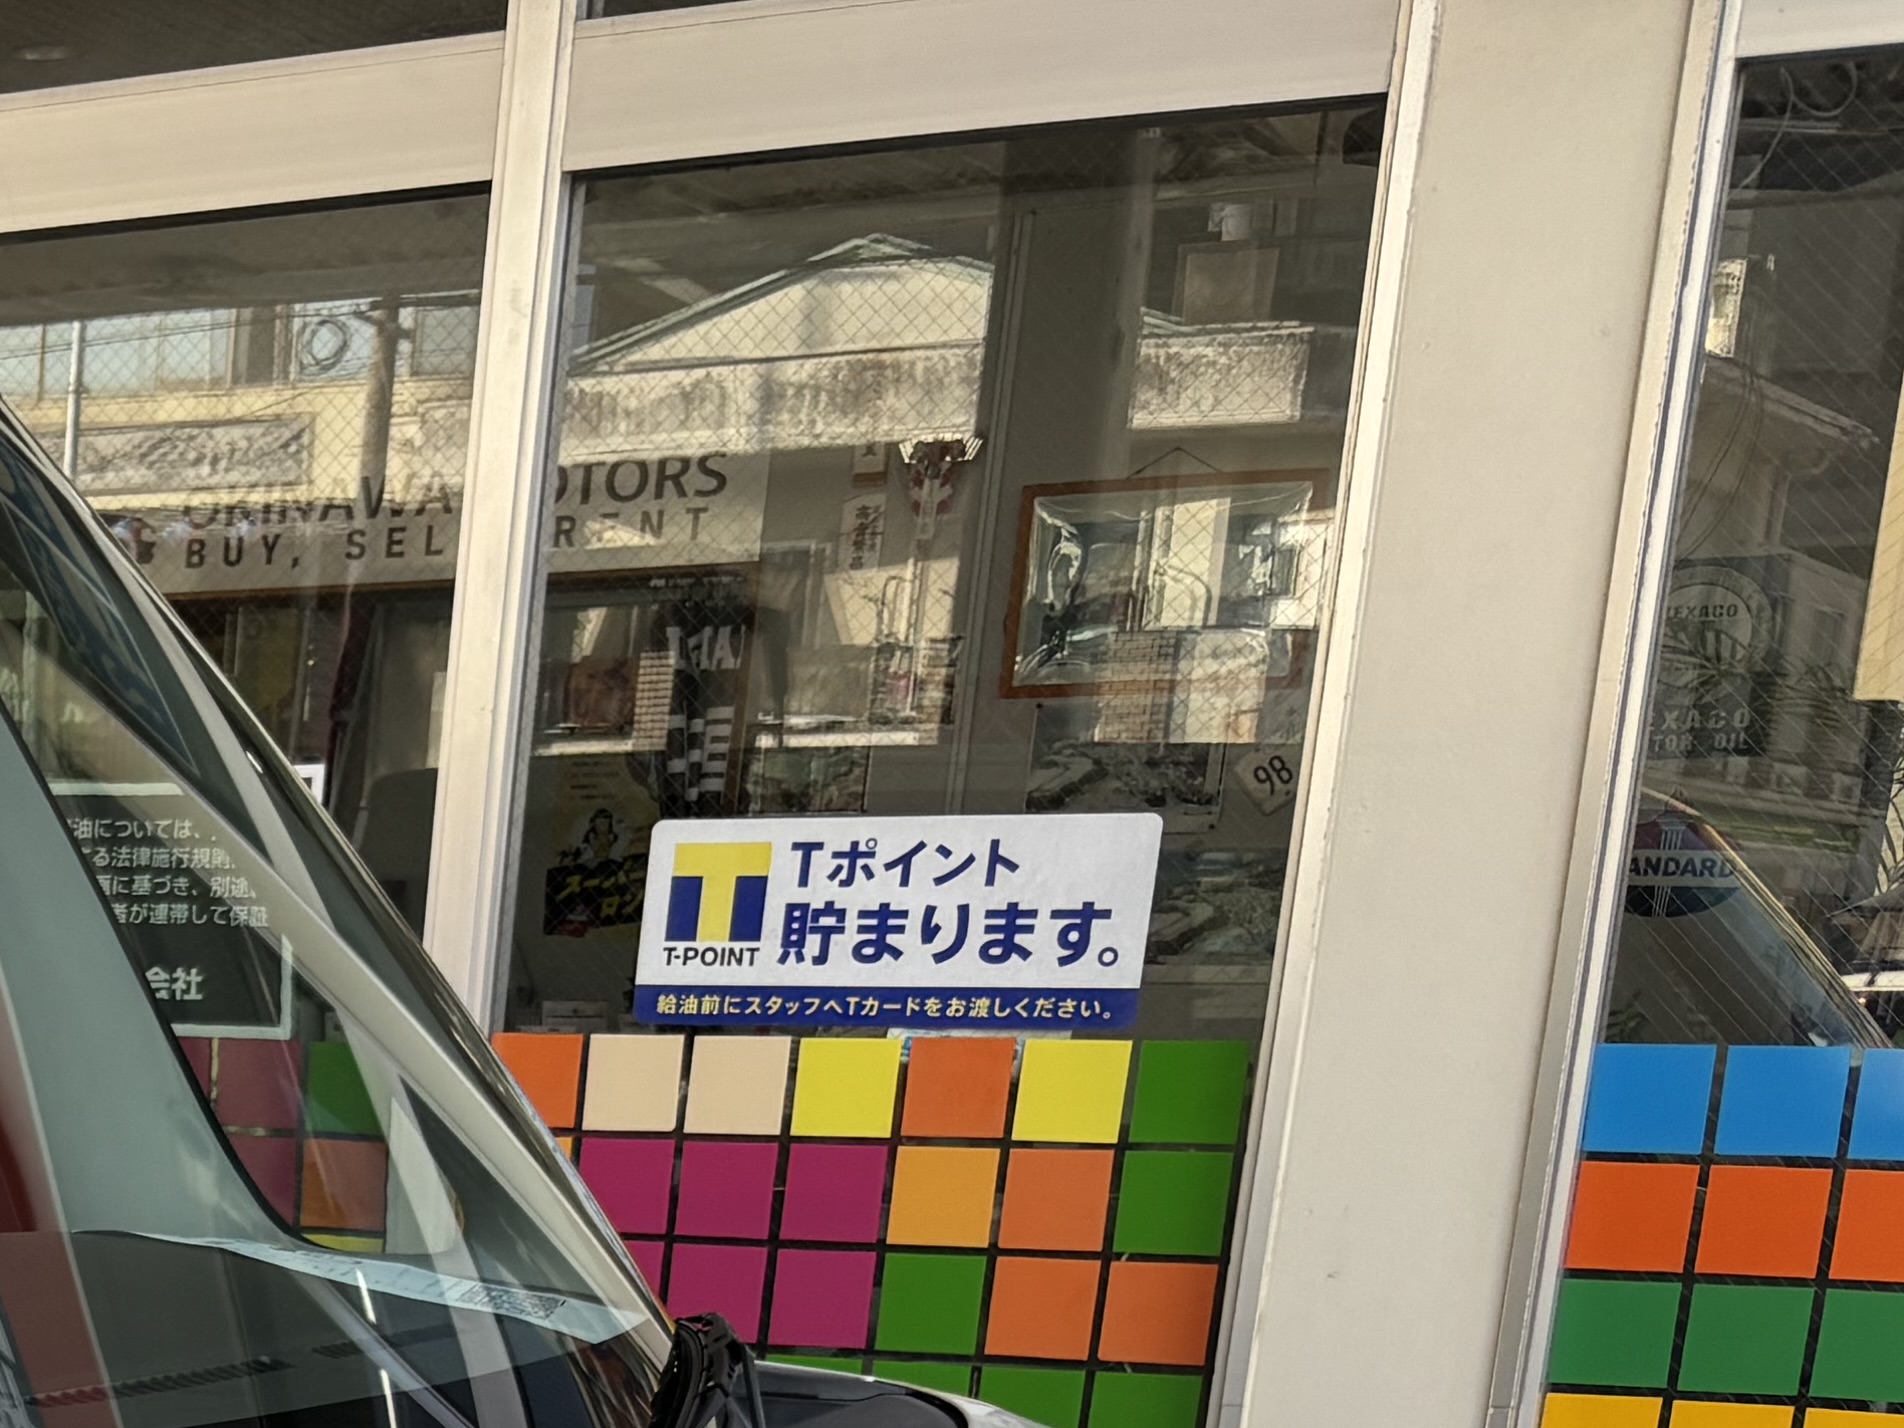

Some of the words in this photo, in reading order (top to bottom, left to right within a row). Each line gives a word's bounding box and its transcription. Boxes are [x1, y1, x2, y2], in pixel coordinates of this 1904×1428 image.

[1254, 755, 1293, 796] 98
[791, 838, 1021, 888] Tポイント
[777, 901, 1120, 968] 貯まります。
[663, 946, 760, 967] T-POINT
[656, 993, 1113, 1021] 給油前にスタッフへTカードをお渡しください。
